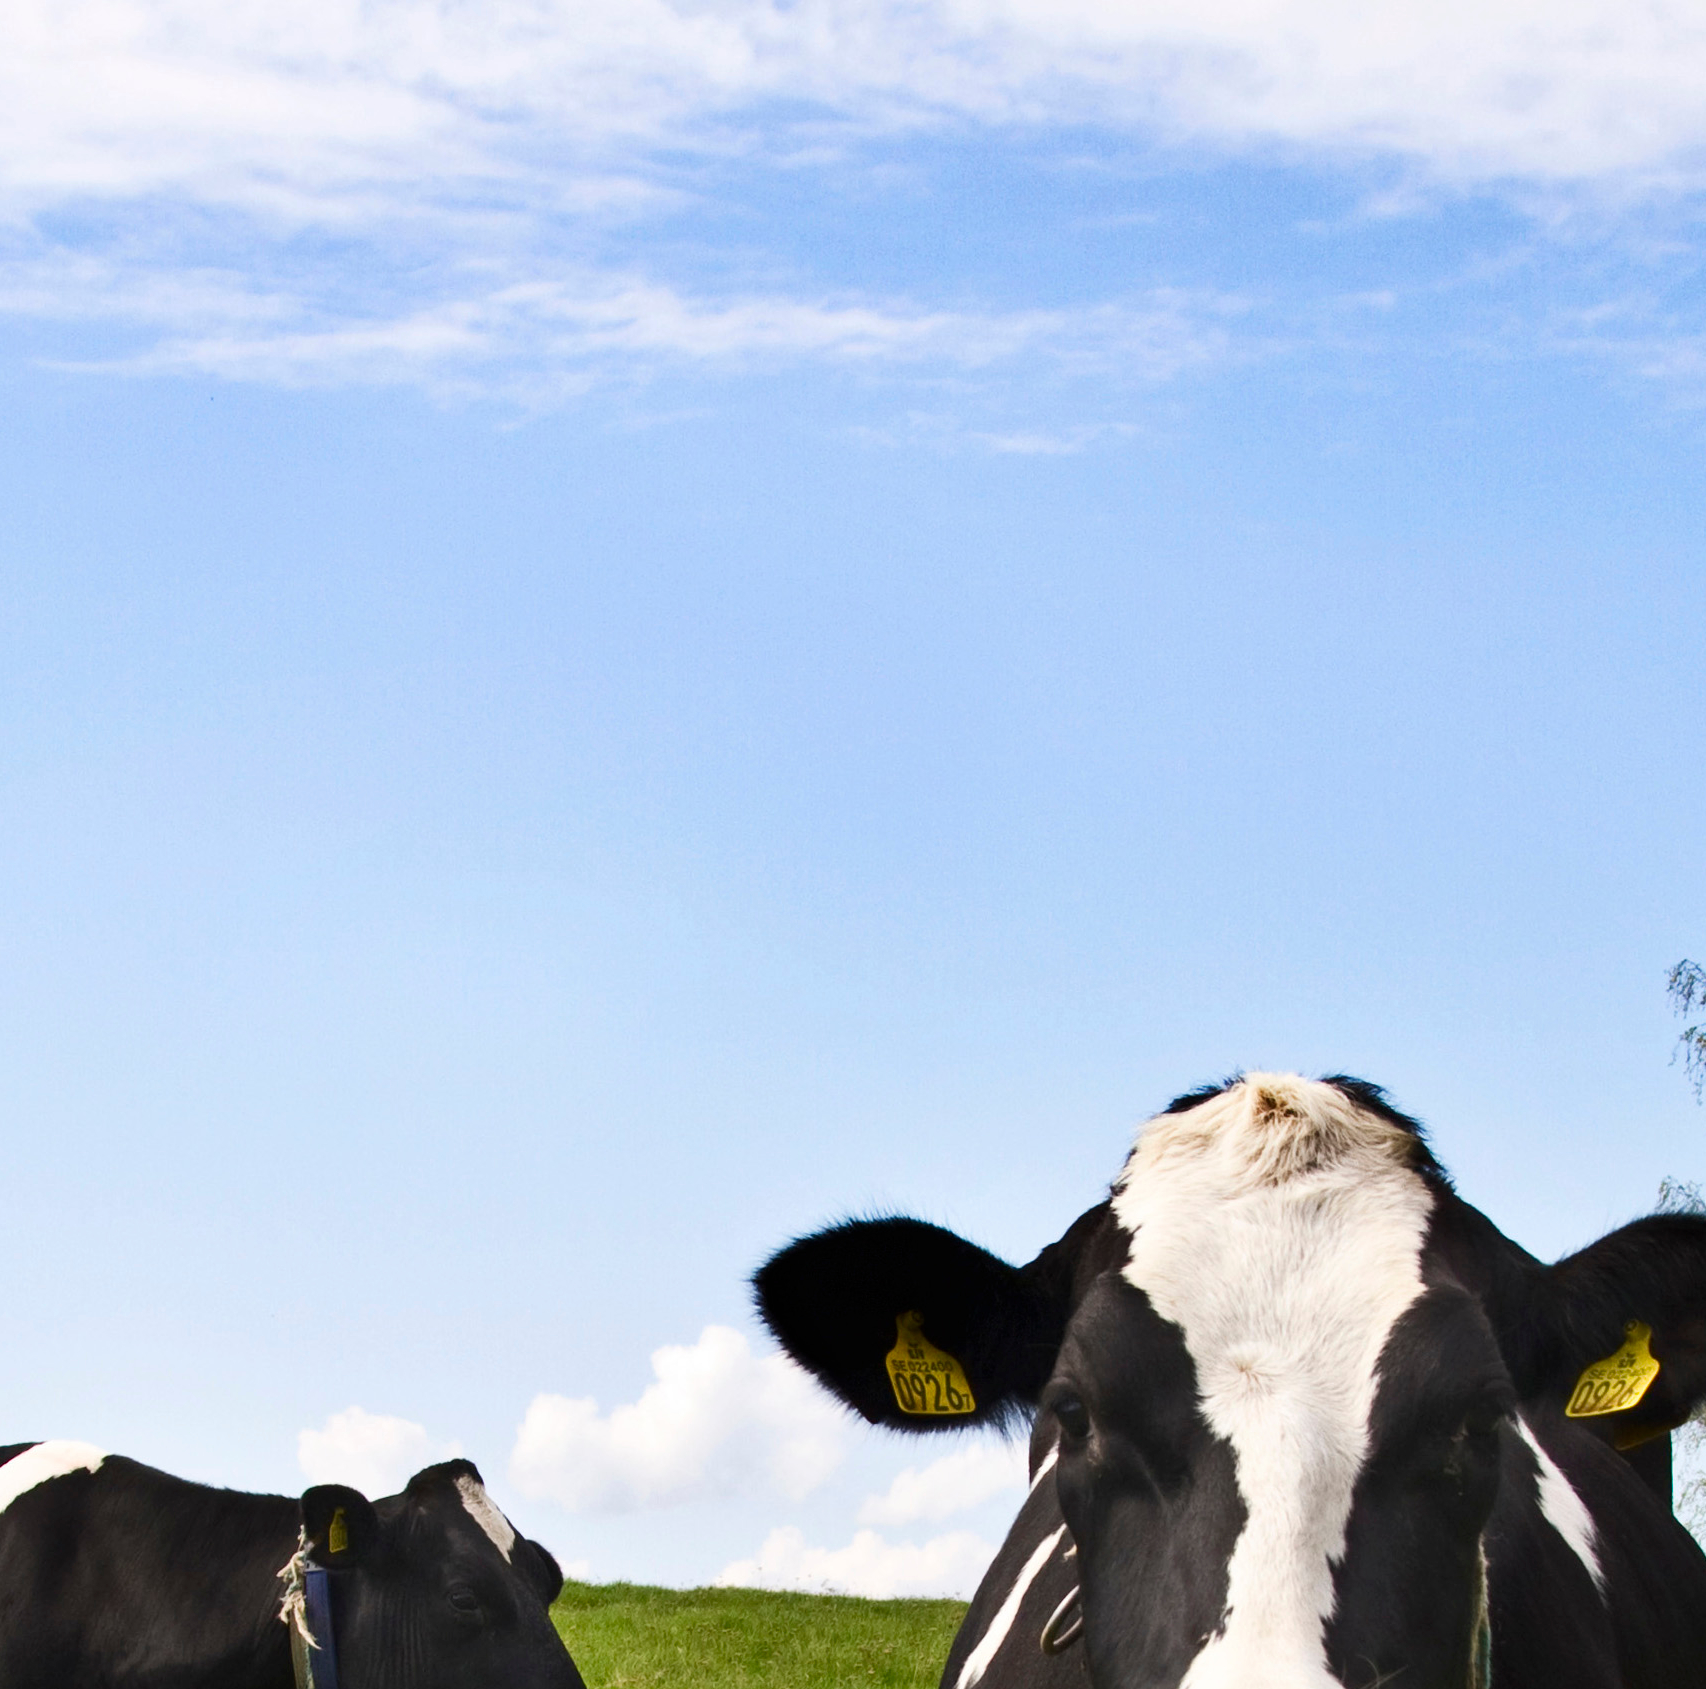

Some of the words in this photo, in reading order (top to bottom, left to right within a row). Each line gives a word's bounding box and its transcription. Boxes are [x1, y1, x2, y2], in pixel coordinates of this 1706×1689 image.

[891, 1359, 908, 1372] SE
[895, 1372, 963, 1411] 0926
[1570, 1377, 1642, 1414] 0926
